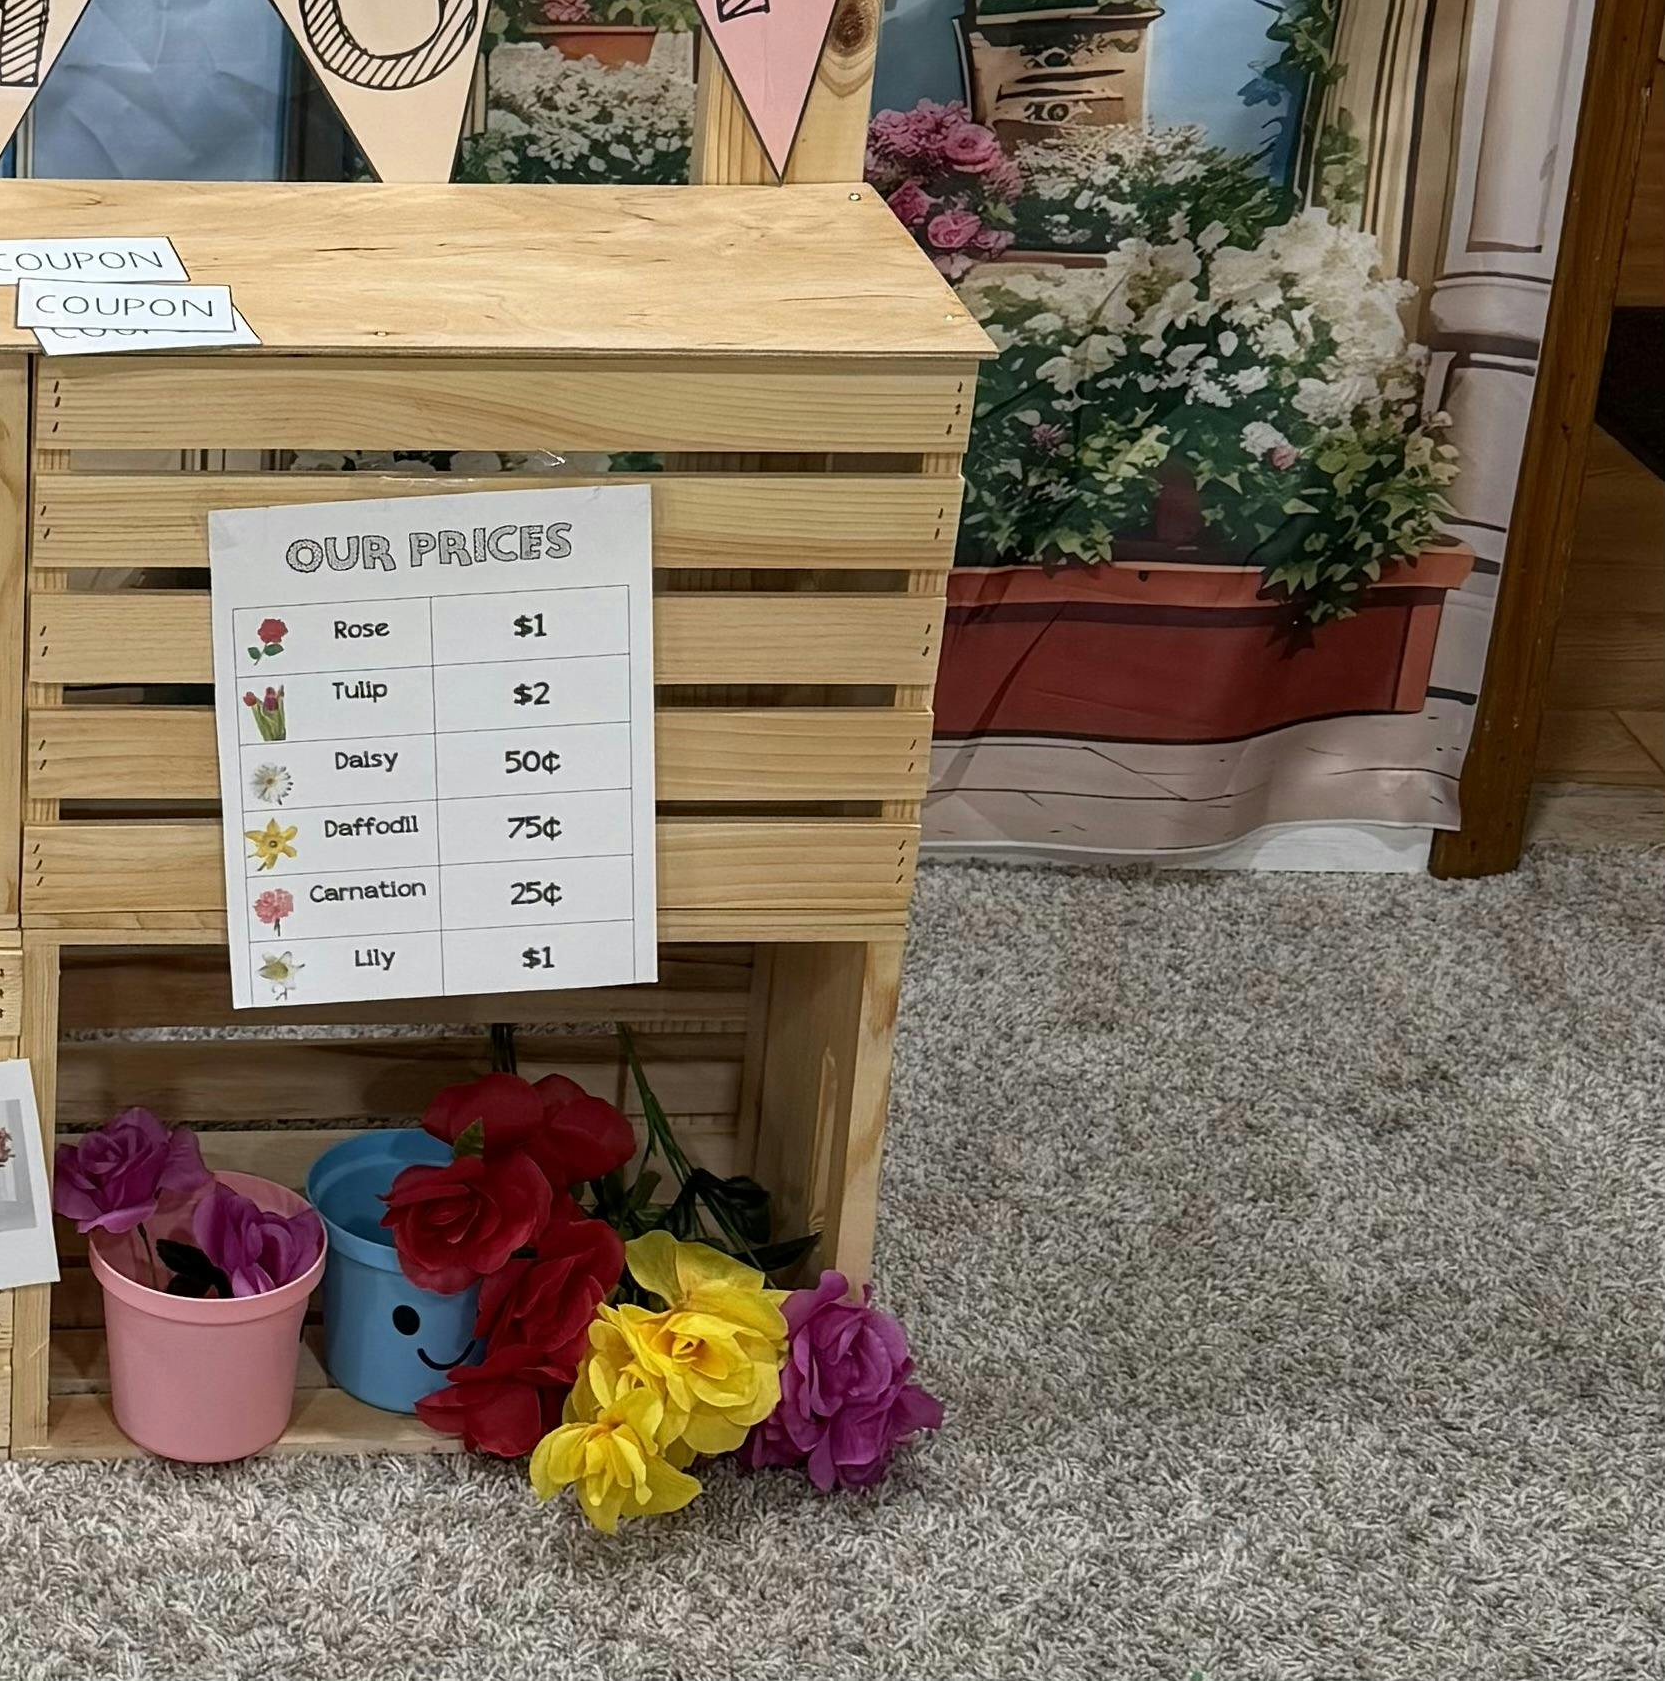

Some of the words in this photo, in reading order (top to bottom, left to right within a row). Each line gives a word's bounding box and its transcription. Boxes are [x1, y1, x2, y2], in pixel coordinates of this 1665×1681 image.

[35, 294, 213, 318] COUPON
[285, 534, 397, 574] OUR
[408, 521, 573, 568] PRICES
[333, 619, 391, 640] Rose
[513, 613, 547, 638] $1
[332, 680, 388, 702] Tulip
[513, 682, 551, 707] $2
[334, 750, 398, 772] Daisy
[504, 750, 561, 774] 50¢
[324, 815, 419, 839] Daffodil
[507, 815, 562, 841] 75¢
[309, 880, 427, 904] Carnation
[510, 881, 563, 906] 25¢
[354, 947, 396, 970] Lily
[522, 946, 554, 970] $1
